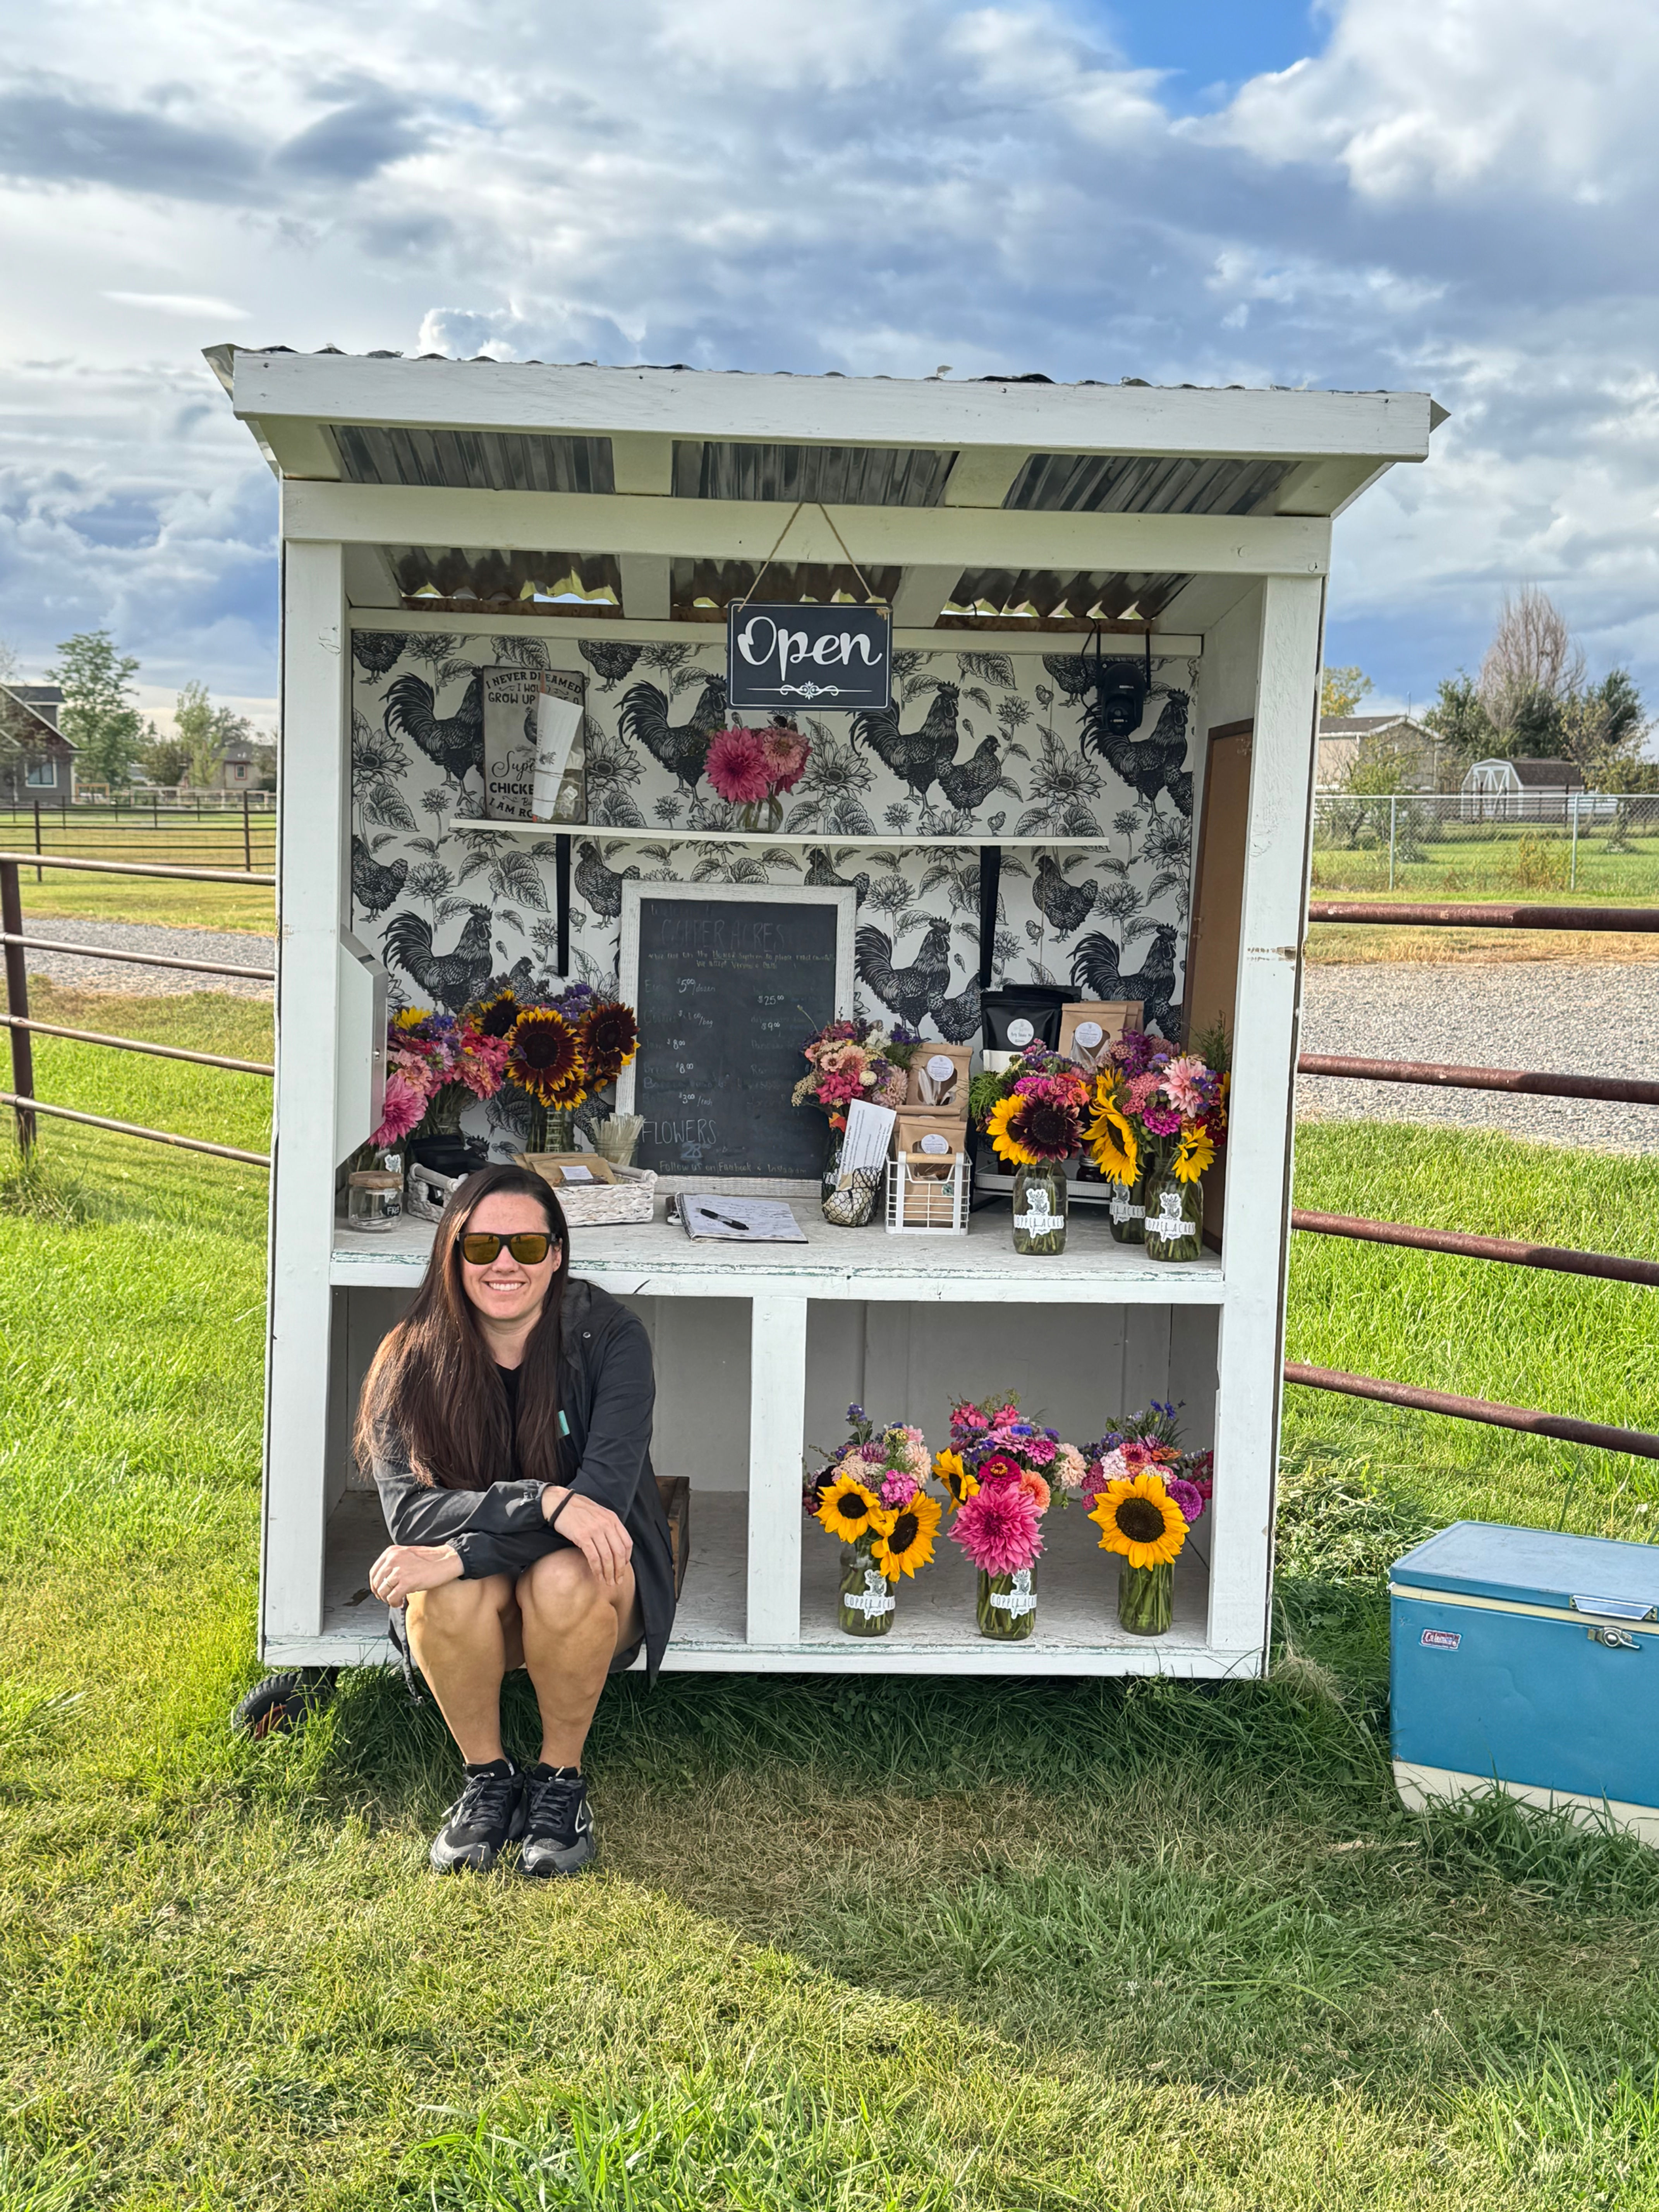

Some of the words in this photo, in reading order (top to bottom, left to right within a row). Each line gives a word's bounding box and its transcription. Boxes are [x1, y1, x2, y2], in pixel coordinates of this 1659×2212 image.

[738, 616, 883, 682] Open
[486, 681, 491, 689] I
[492, 672, 527, 686] NEVER
[517, 683, 521, 692] I
[488, 692, 518, 704] GROW
[522, 694, 536, 704] UP
[489, 782, 534, 795] CHICKE
[489, 797, 495, 806] I
[496, 801, 515, 814] AM
[642, 1120, 716, 1144] FLOWERS
[659, 1160, 689, 1172] Follow
